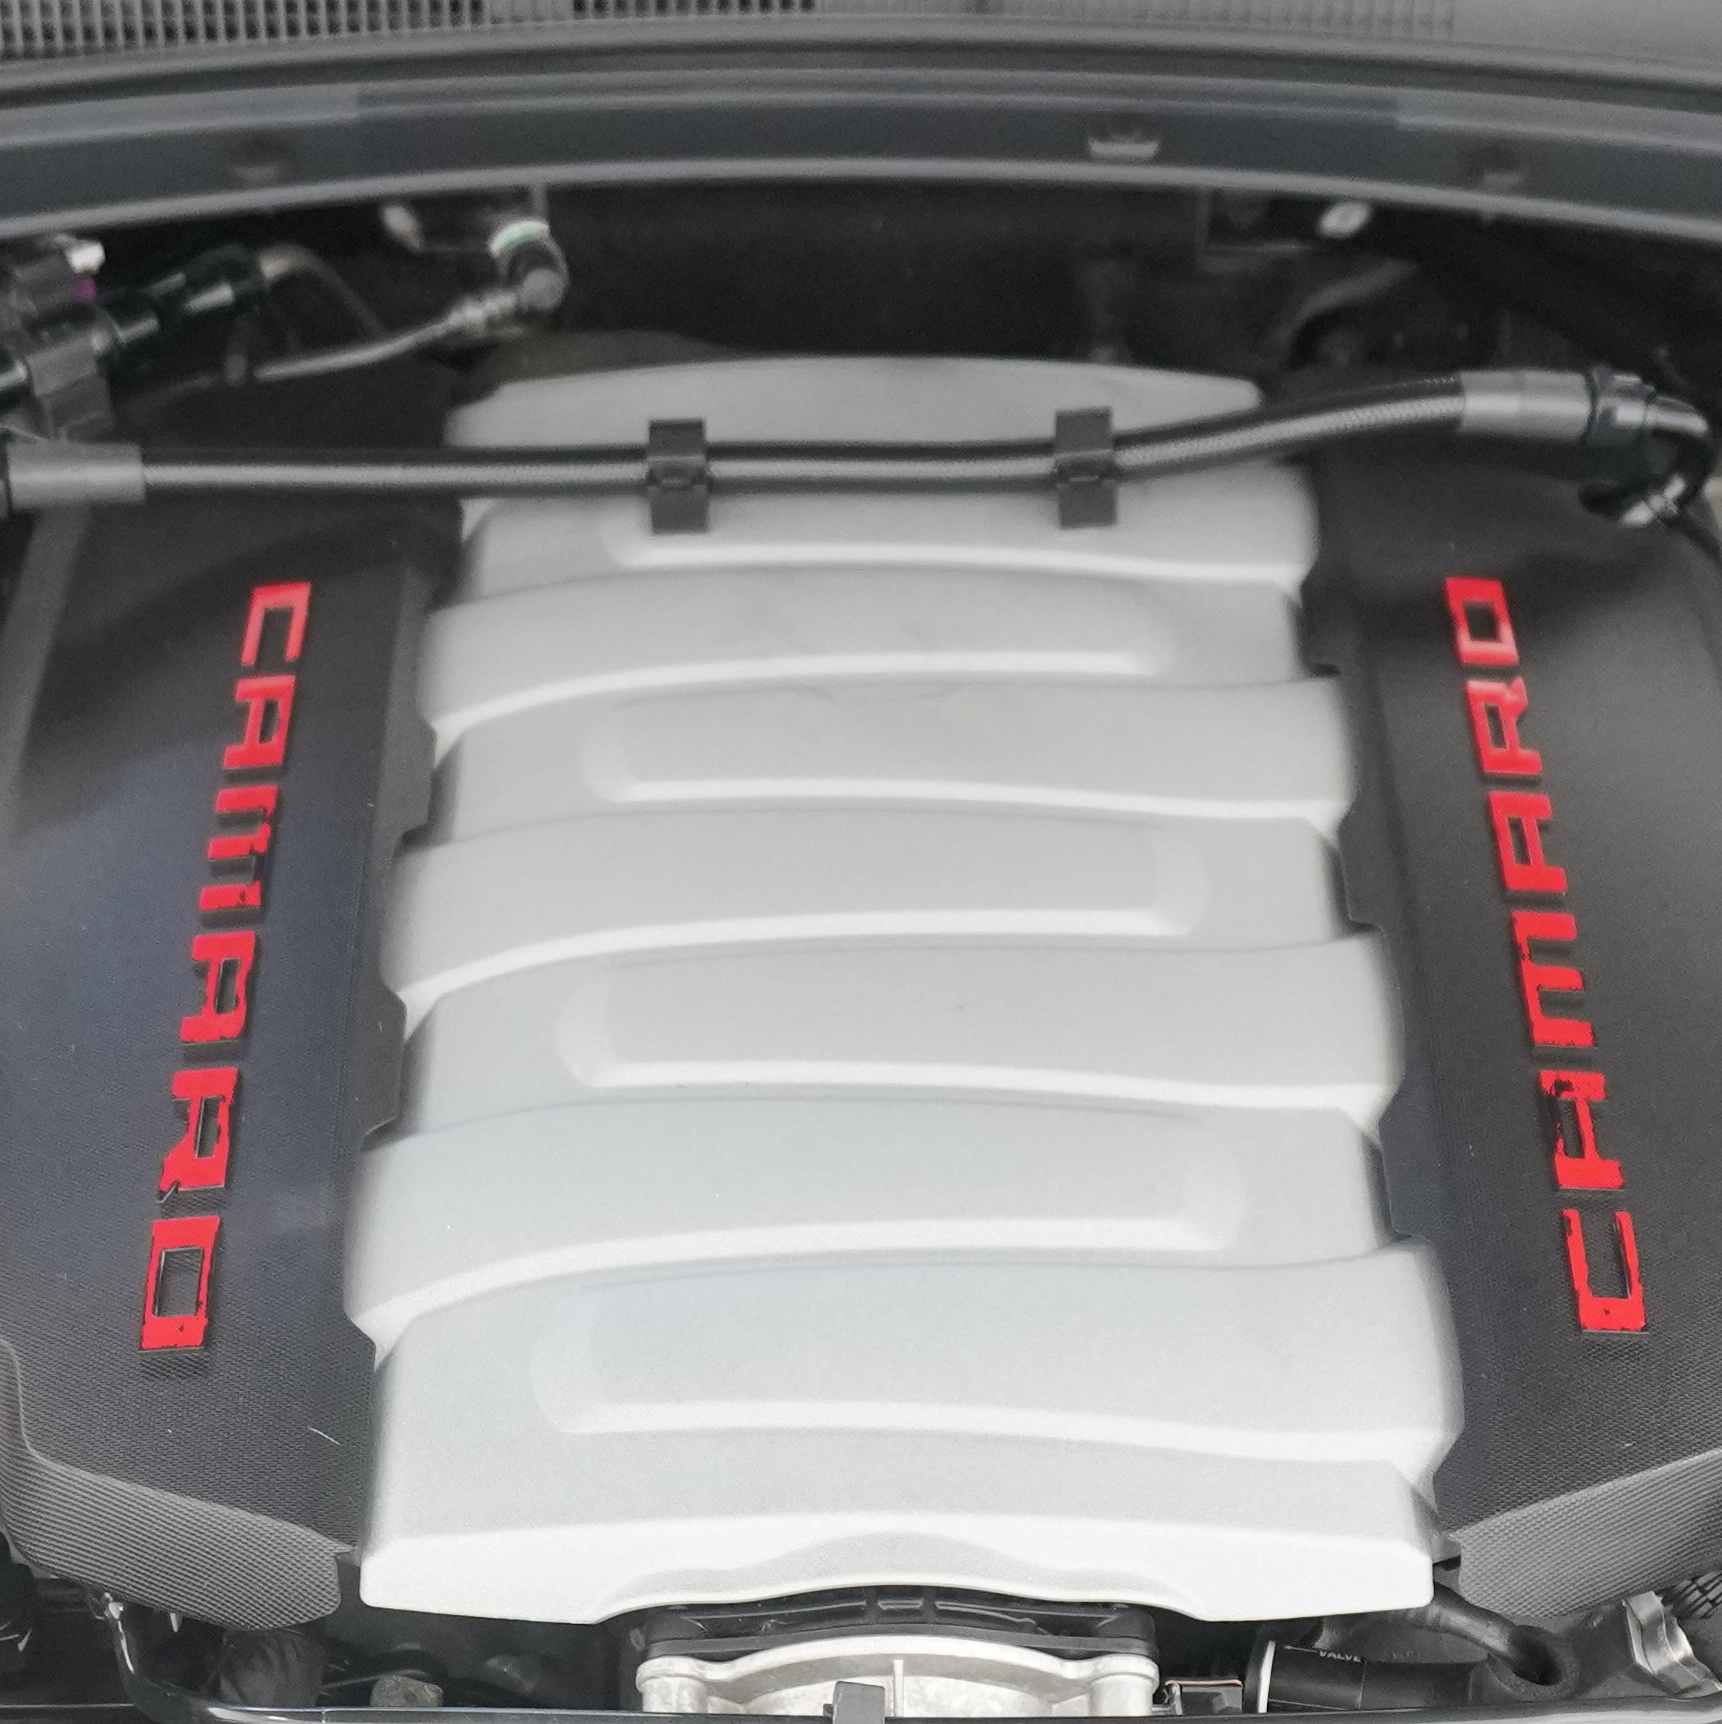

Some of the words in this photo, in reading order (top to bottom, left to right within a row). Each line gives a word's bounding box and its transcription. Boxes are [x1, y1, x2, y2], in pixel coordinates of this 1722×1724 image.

[140, 582, 311, 1350] CAMARO
[1445, 577, 1647, 1332] CAMARO
[1318, 1649, 1362, 1663] VALVE
